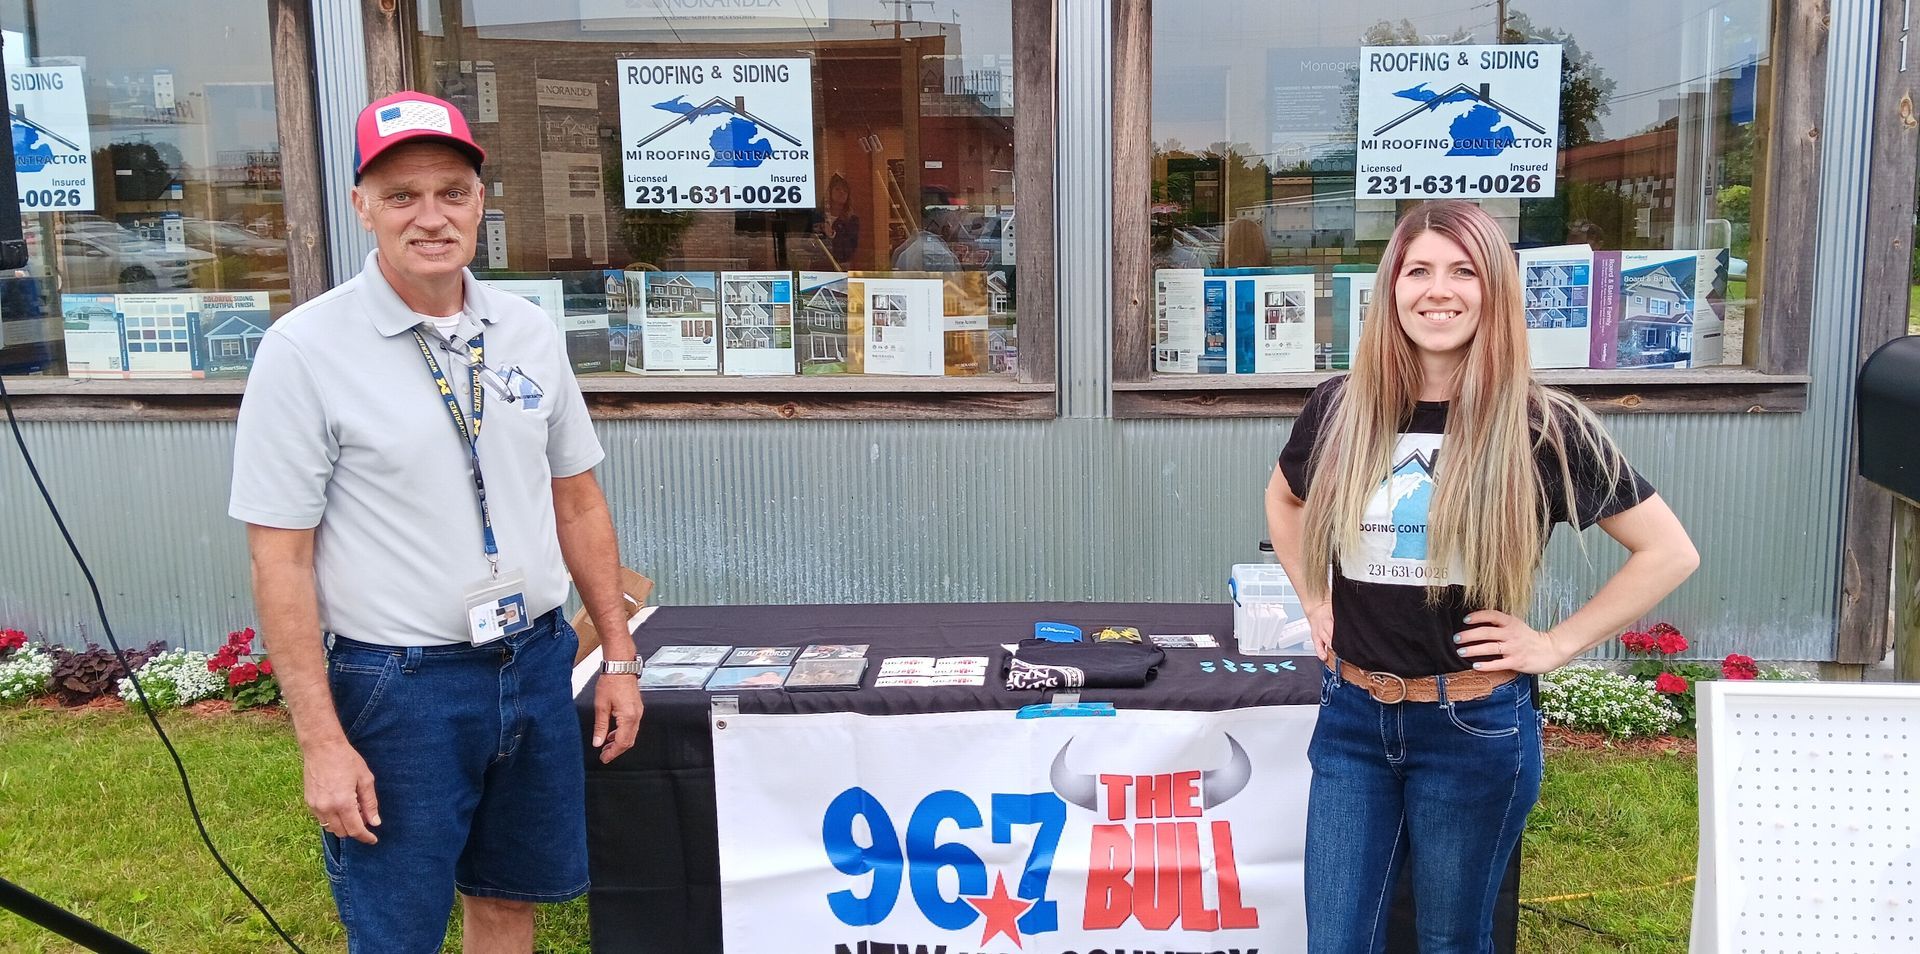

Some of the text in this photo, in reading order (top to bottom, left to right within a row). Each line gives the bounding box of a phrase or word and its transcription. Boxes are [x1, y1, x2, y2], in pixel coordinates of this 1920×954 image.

[1300, 60, 1358, 72] Monogra
[1370, 50, 1539, 72] ROOFING & SIDING
[627, 64, 789, 85] ROOFING & SIDING
[10, 72, 64, 92] SIDING
[545, 85, 593, 98] NORANDEX
[1361, 138, 1552, 150] MI ROOFING CONTRACTOR
[17, 154, 87, 165] NTRACTOR
[626, 150, 809, 161] MI ROOFING CONTRACTOR
[1361, 164, 1402, 173] Licensed
[1510, 163, 1548, 172] Insured
[52, 177, 86, 187] Insured
[628, 174, 668, 183] Licensed
[770, 174, 807, 183] Insured
[1367, 174, 1541, 194] 231-631-0026
[635, 185, 802, 204] 231-631-0026
[1359, 523, 1426, 534] OOFING CONT
[1368, 563, 1448, 578] 231-631-0026
[1100, 770, 1203, 820] THE
[1083, 821, 1260, 932] BULL
